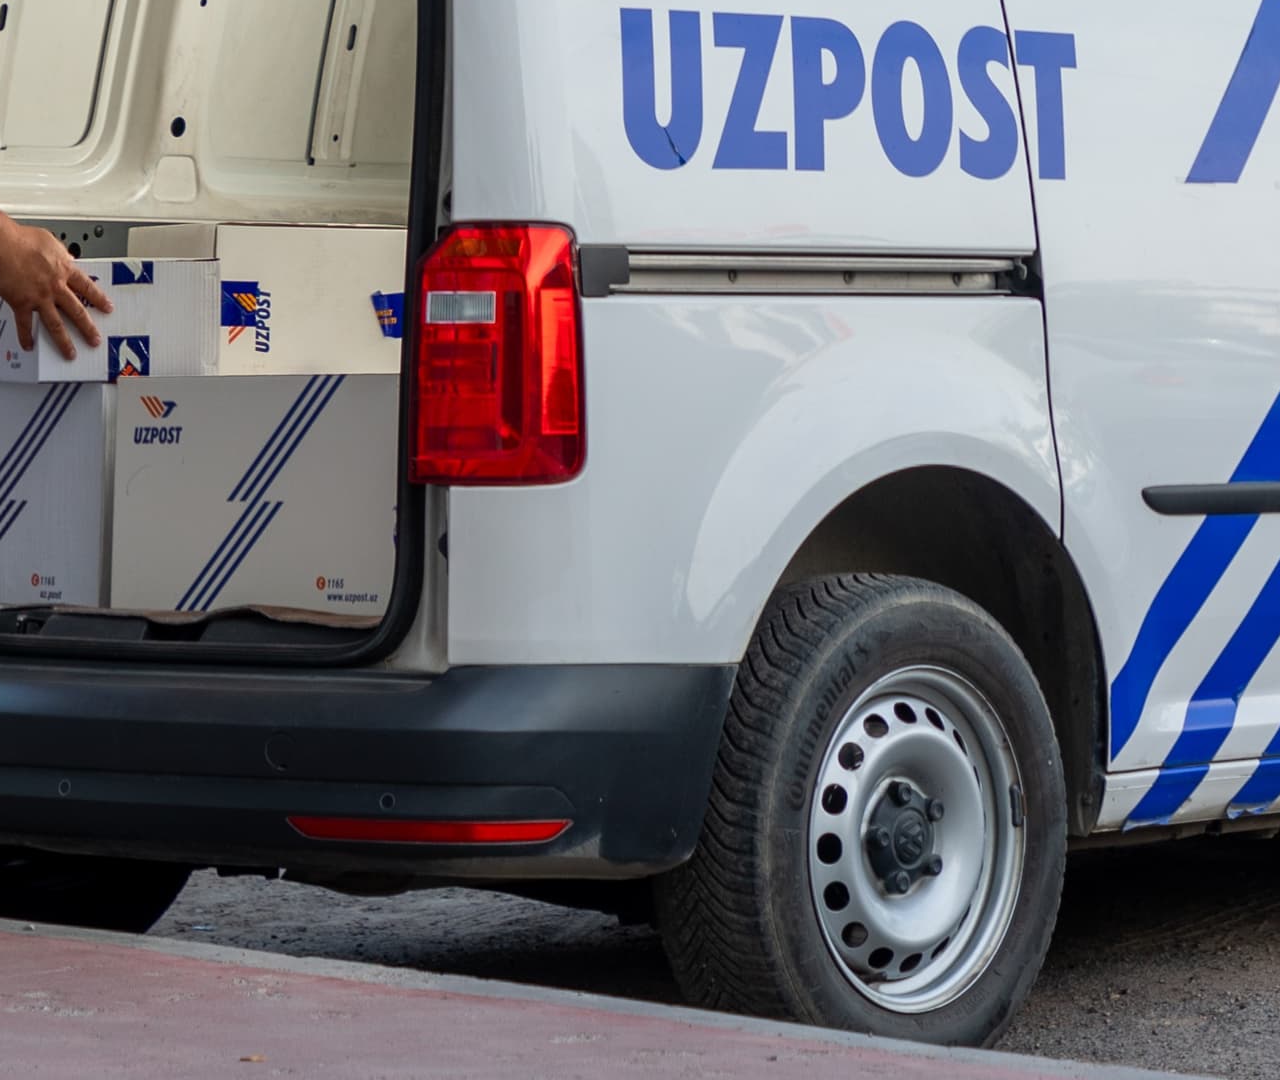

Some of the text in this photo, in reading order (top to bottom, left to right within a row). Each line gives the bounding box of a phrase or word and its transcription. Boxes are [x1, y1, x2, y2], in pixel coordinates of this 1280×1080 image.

[619, 7, 1077, 181] UZPOST
[134, 426, 182, 445] UZPOST
[327, 578, 345, 589] 1165
[327, 593, 379, 604] www.uzpost.uz
